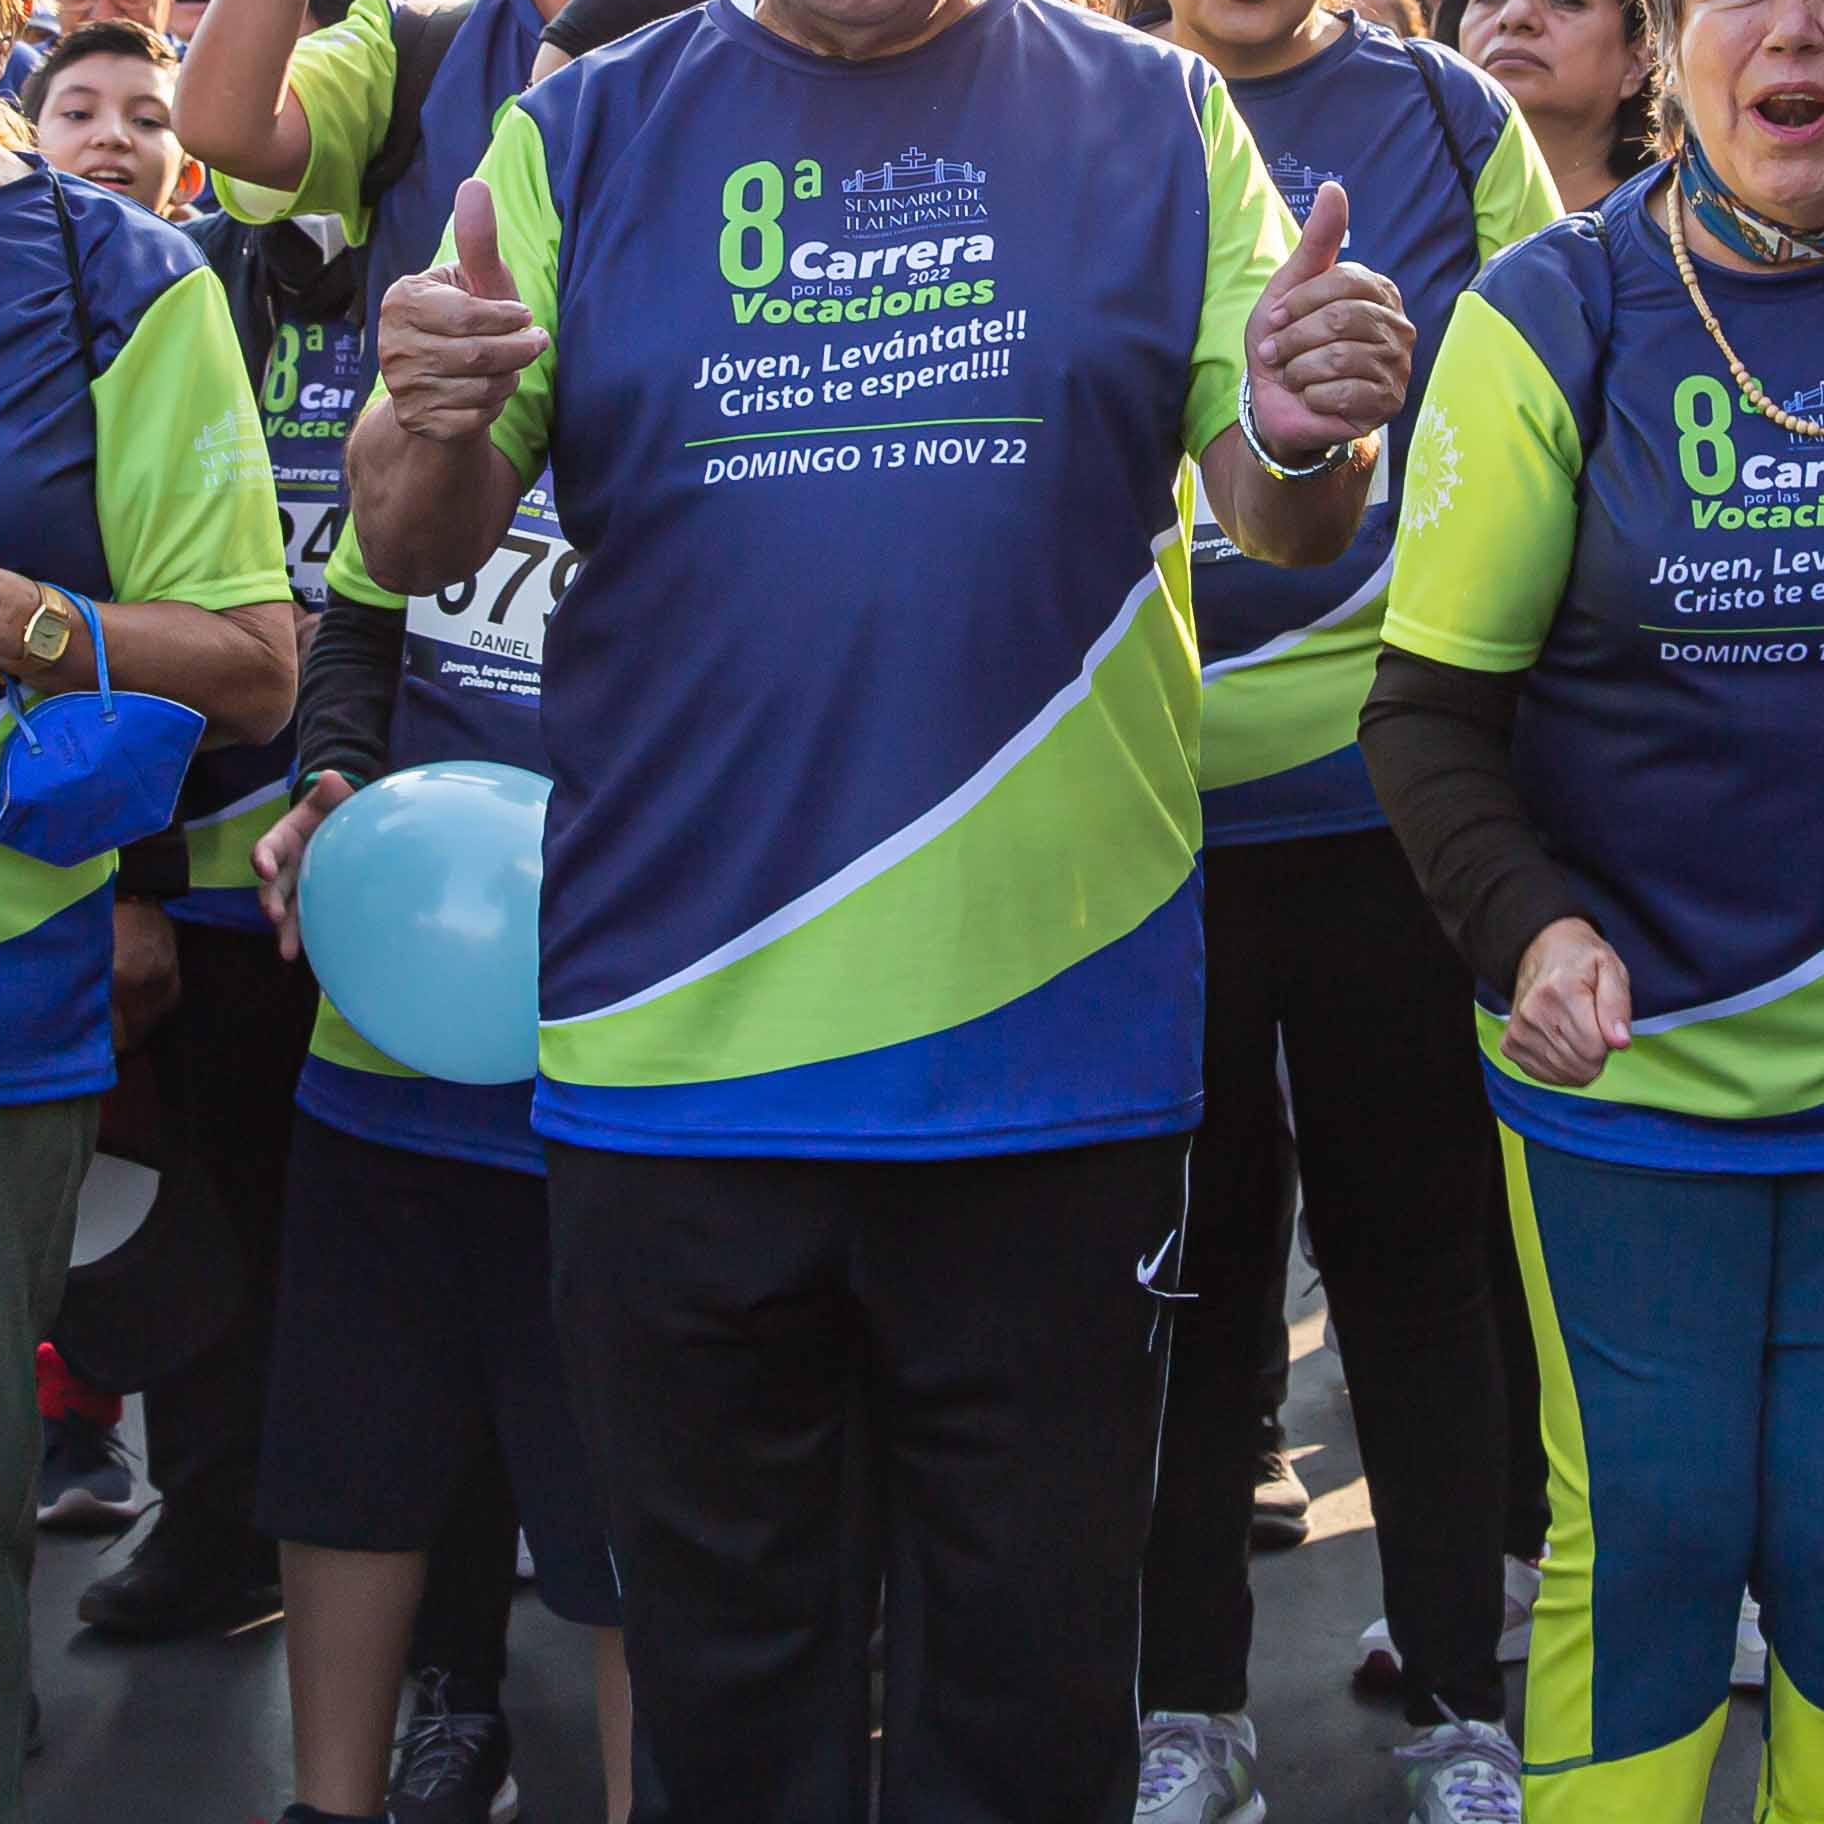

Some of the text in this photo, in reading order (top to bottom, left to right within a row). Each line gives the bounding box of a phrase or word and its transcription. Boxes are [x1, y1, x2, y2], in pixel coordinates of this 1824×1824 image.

[844, 188, 981, 212] SEMINARIO DE
[842, 204, 989, 232] TLALNEPANTLA
[789, 234, 995, 280] Carrera
[791, 281, 854, 299] por las
[907, 267, 950, 286] 2022
[731, 277, 995, 325] Vocaciones
[694, 310, 1027, 390] Jóven, Levántate!!
[719, 349, 1010, 417] Cristo te espera!!!!
[703, 438, 1027, 485] DOMINGO 13 NOV 22
[1744, 492, 1772, 507] por
[1777, 490, 1801, 504] las
[1649, 554, 1763, 585] Jóven,
[1674, 587, 1765, 614] Cristo
[1773, 584, 1802, 605] te
[469, 630, 534, 659] DANIEL
[1660, 642, 1808, 663] DOMINGO
